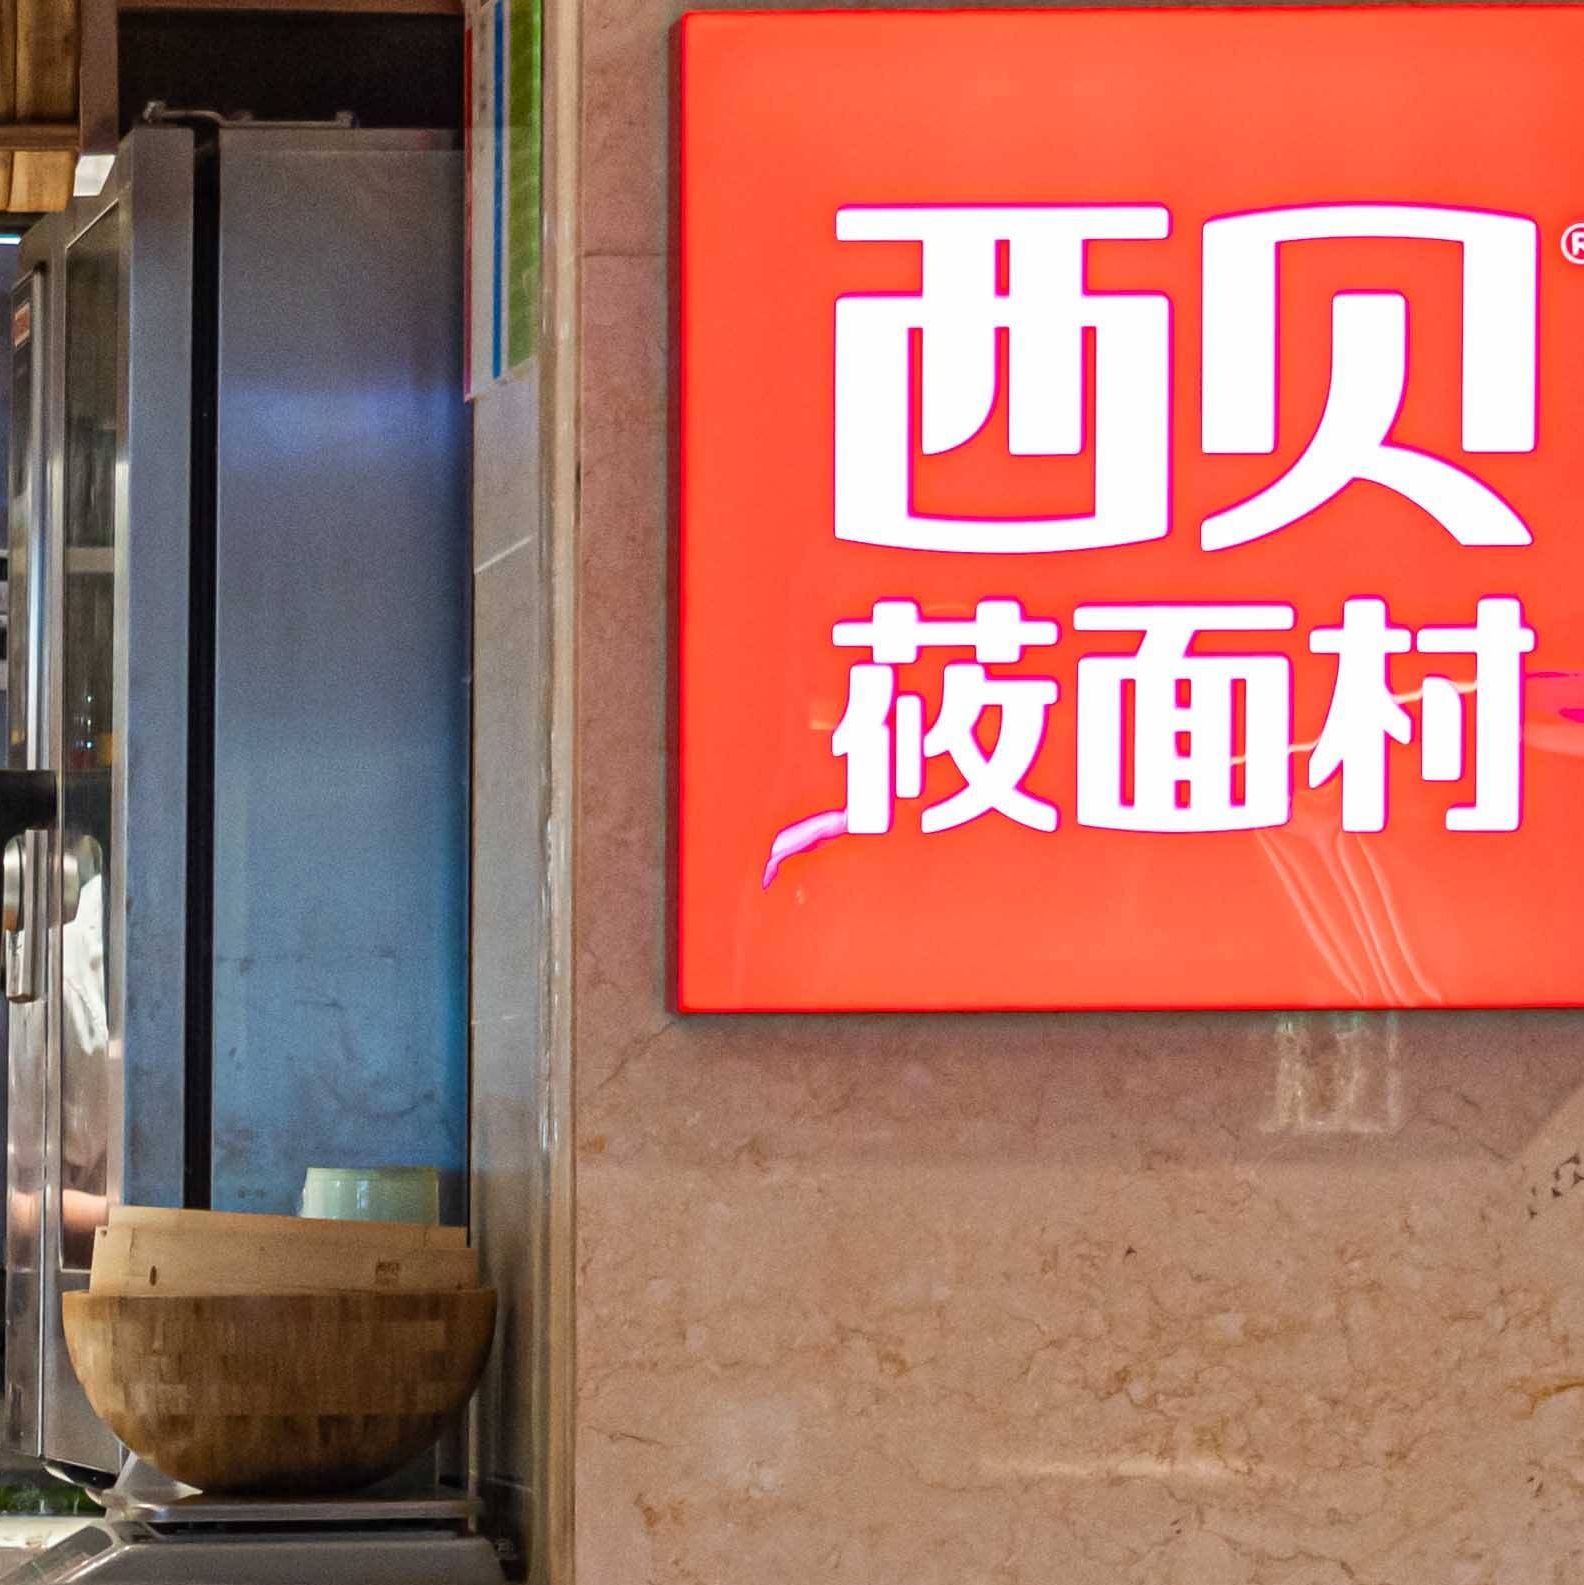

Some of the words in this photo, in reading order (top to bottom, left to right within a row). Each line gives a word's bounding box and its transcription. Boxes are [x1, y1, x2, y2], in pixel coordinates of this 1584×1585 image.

[834, 203, 1537, 554] 西贝
[832, 597, 1536, 834] 莜面村
